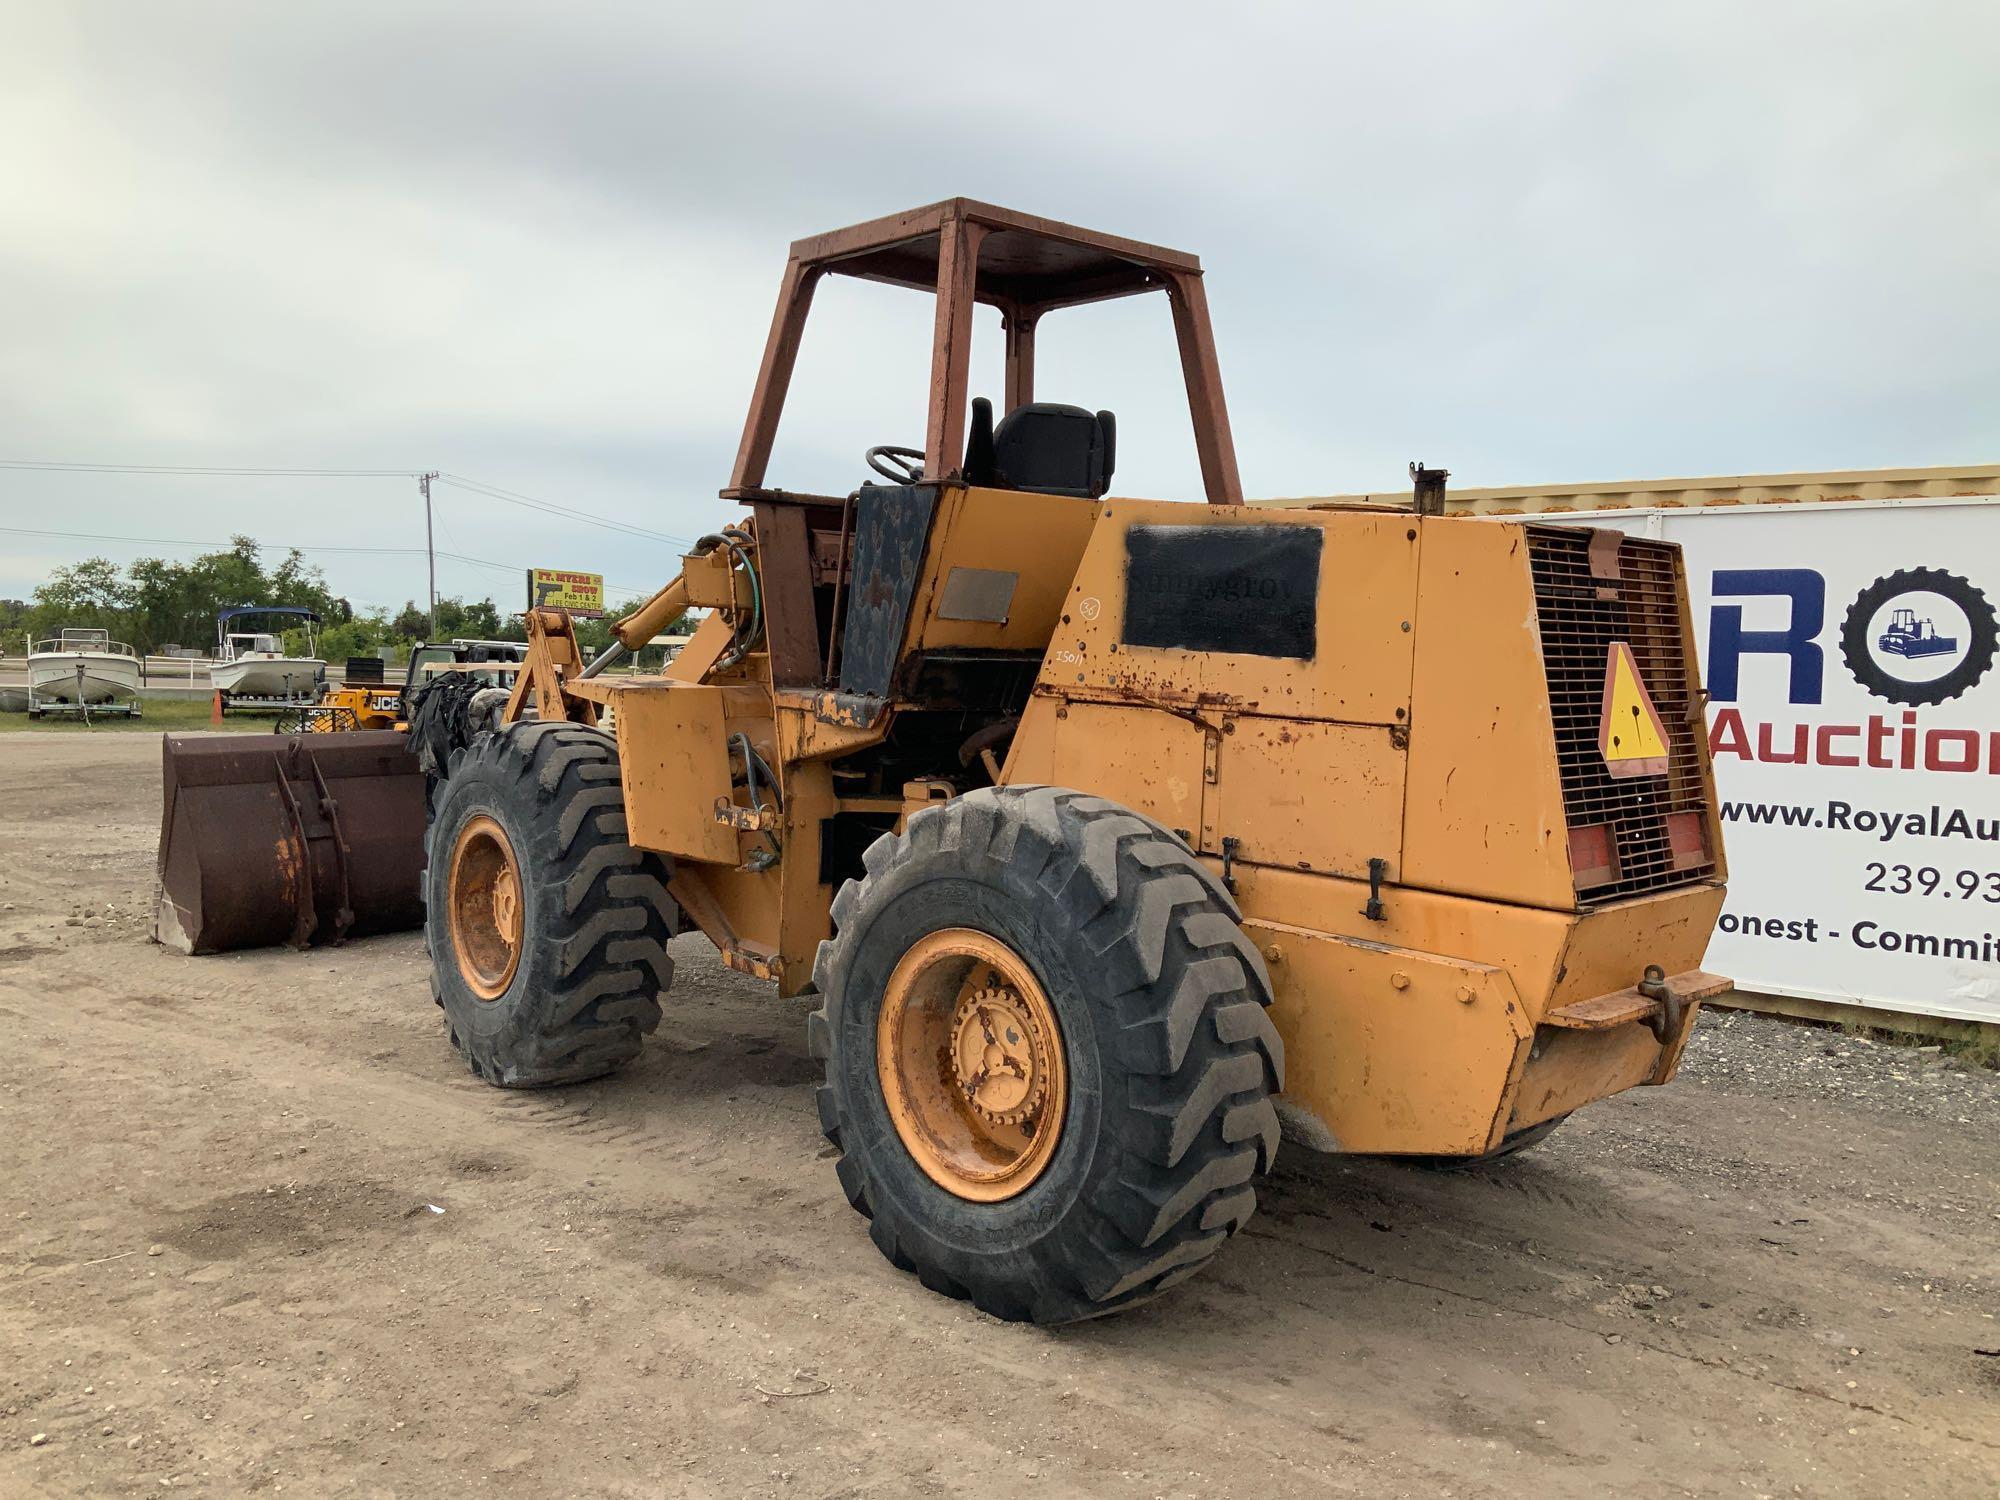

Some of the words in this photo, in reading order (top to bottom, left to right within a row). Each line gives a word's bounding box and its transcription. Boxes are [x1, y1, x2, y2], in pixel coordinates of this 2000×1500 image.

[564, 592, 578, 600] Feb
[571, 585, 598, 595] SHOW
[372, 696, 400, 711] JCB
[1709, 708, 2000, 775] Auctio
[1864, 862, 2000, 903] 239.93
[1718, 913, 1818, 943] onest
